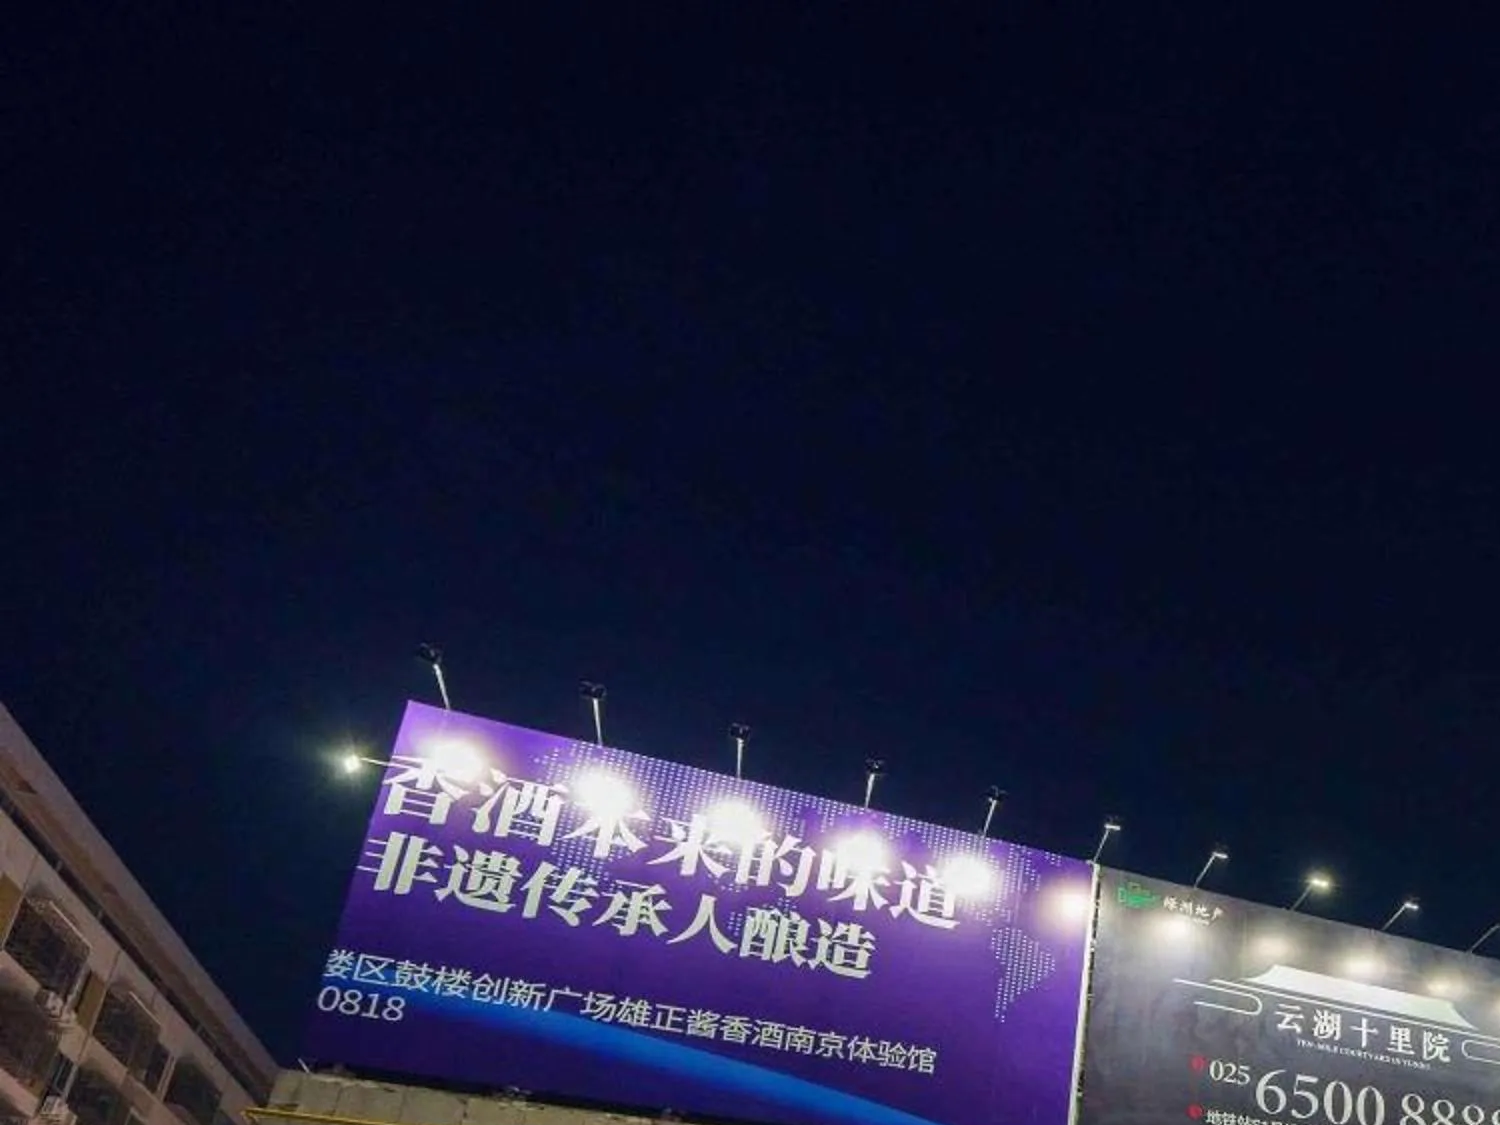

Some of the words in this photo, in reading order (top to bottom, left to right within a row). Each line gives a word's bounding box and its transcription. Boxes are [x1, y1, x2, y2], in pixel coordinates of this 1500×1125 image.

[379, 756, 960, 932] 香酒本来的味道
[356, 832, 876, 980] 非遗传承人酿造
[317, 986, 406, 1022] 0818
[1274, 1003, 1450, 1063] 云湖十里院
[1209, 1059, 1251, 1085] 025
